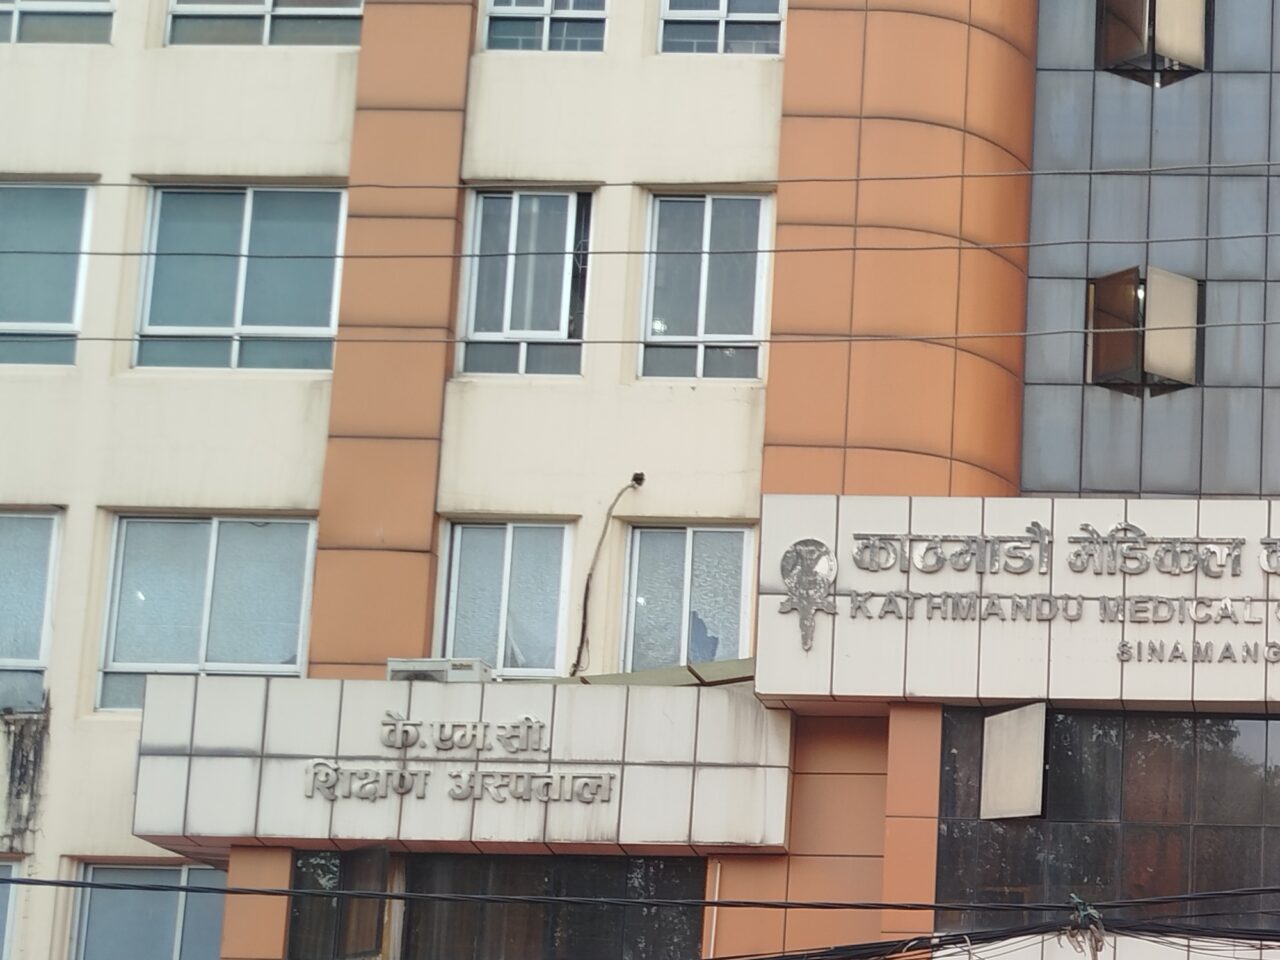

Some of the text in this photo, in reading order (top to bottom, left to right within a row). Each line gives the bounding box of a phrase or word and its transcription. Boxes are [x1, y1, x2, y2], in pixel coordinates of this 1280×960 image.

[1067, 522, 1246, 578] मेडिकल
[850, 590, 1084, 622] KATHMANDU
[1099, 594, 1263, 625] MEDICAL
[303, 758, 616, 804] शिक्षण अस्पताल
